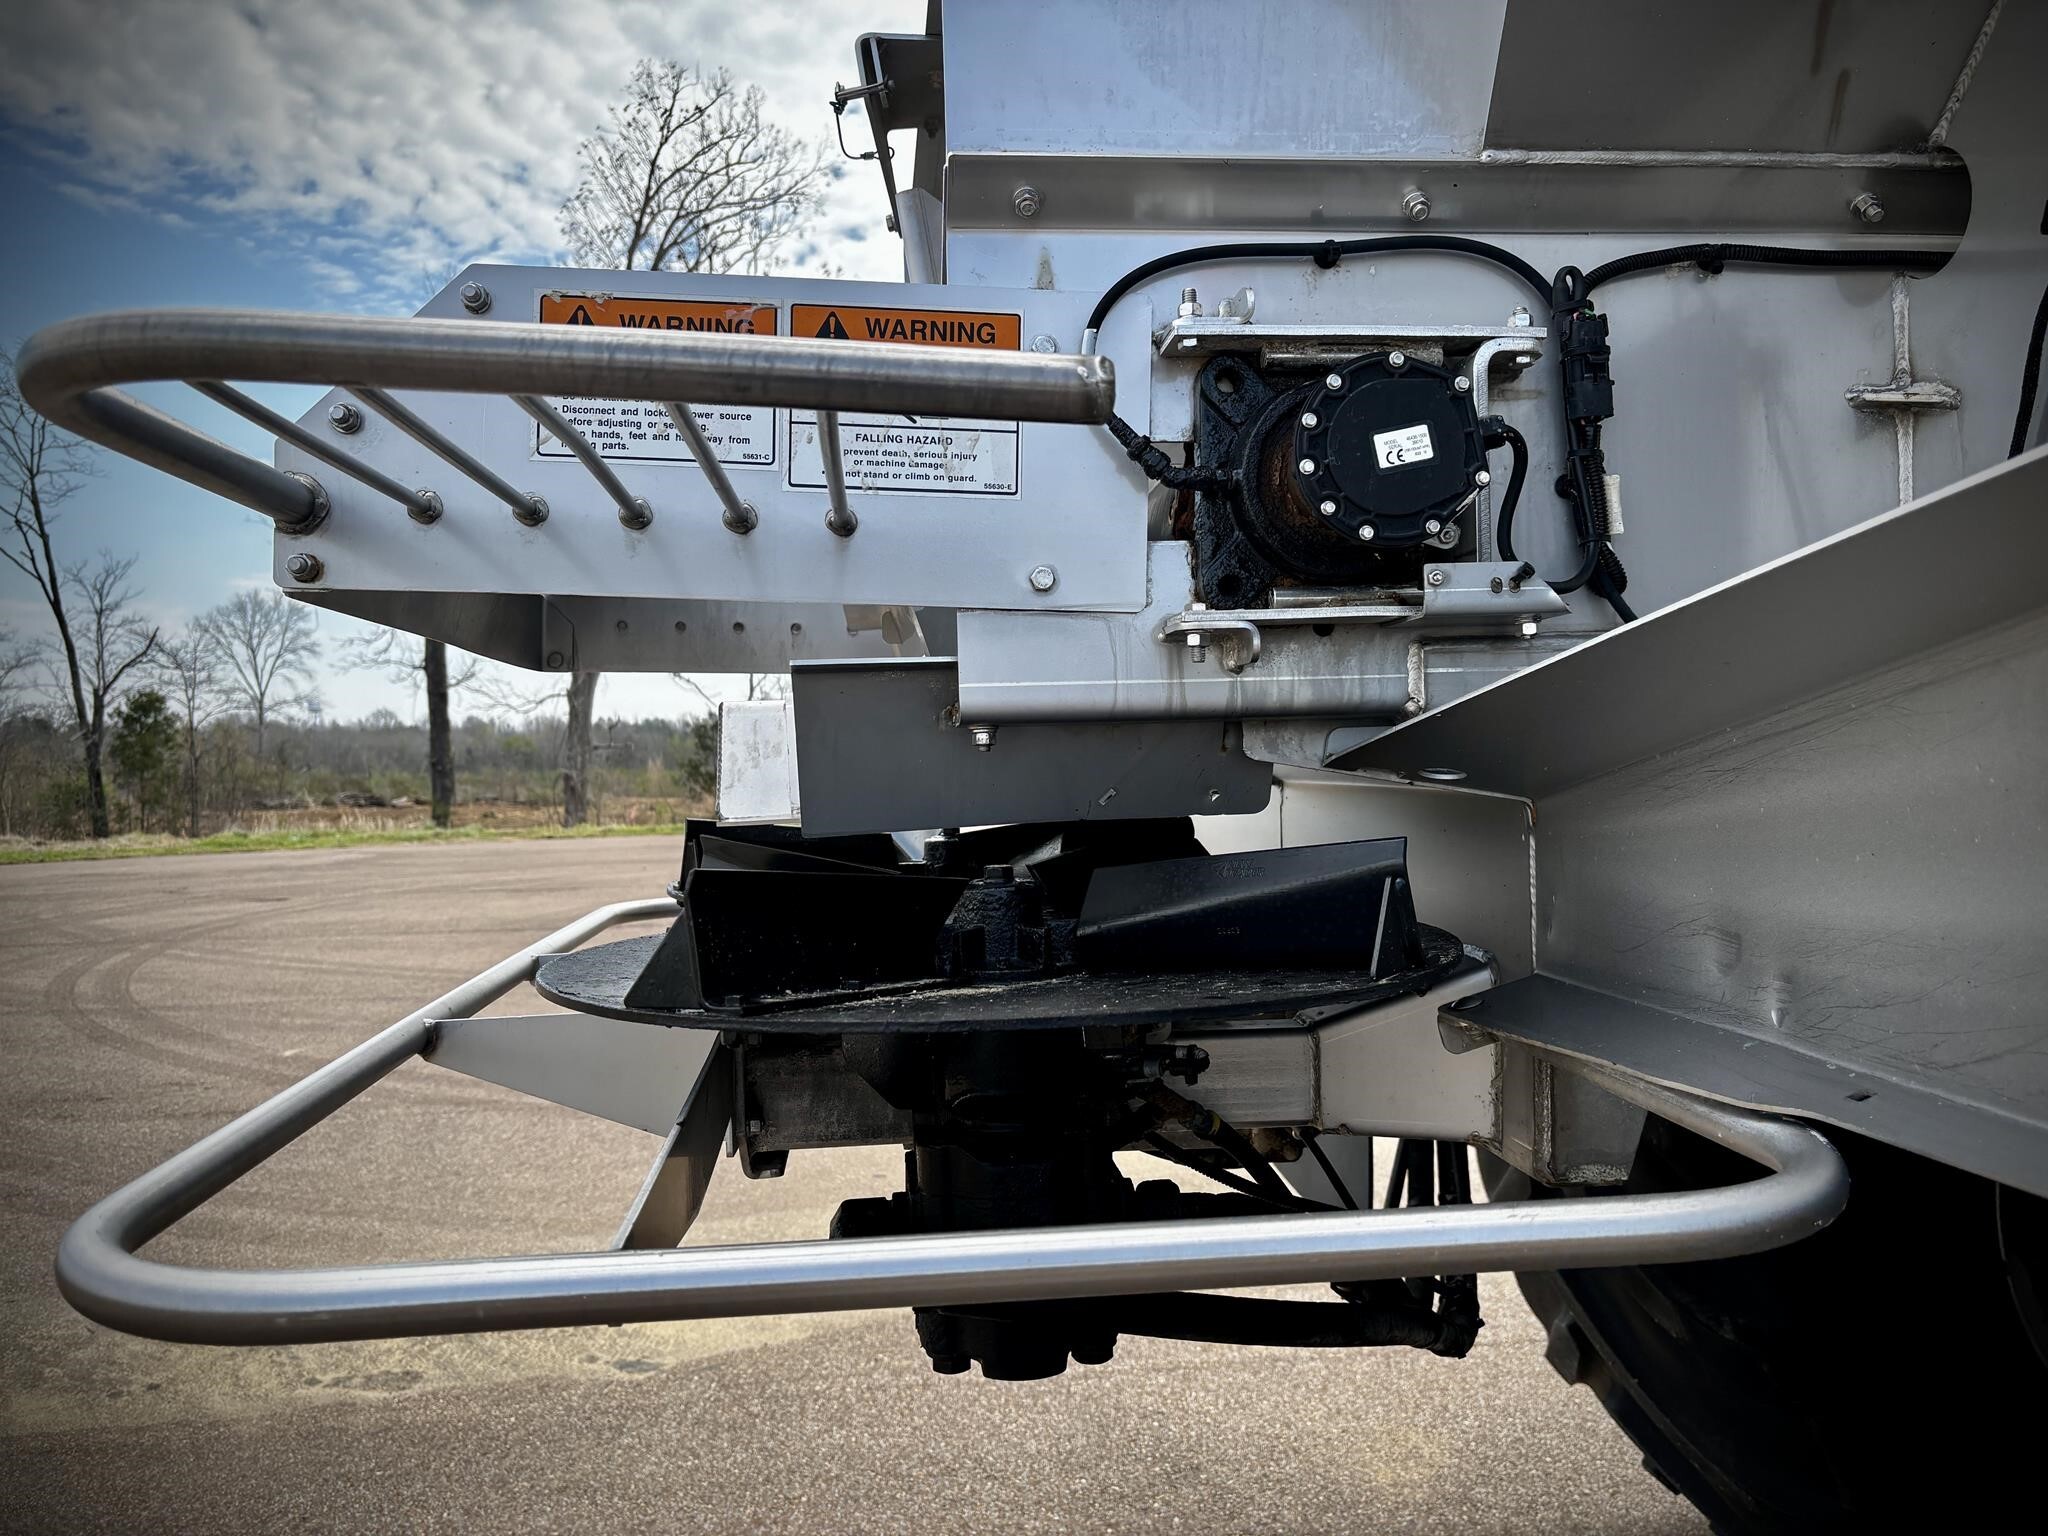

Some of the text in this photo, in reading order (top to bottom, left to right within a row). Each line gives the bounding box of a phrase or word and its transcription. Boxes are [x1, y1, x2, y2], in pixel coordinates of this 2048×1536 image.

[619, 314, 755, 334] WARNING
[865, 317, 996, 345] WARNING
[562, 405, 616, 416] Disconnect
[621, 408, 639, 416] and
[692, 411, 714, 419] ower
[720, 412, 752, 420] source
[568, 418, 592, 426] efore
[598, 419, 642, 430] adjusting
[592, 430, 624, 440] hands,
[629, 431, 647, 440] feet
[706, 436, 723, 445] way
[729, 435, 750, 444] from
[856, 434, 903, 444] FALLING
[602, 442, 630, 451] parts.
[882, 449, 910, 458] death,
[914, 451, 948, 459] serious
[951, 452, 978, 462] injury
[1386, 448, 1406, 464] CE
[866, 460, 906, 468] machine
[864, 470, 889, 479] stand
[948, 474, 977, 483] guard.
[984, 482, 1012, 490] 55630-E
